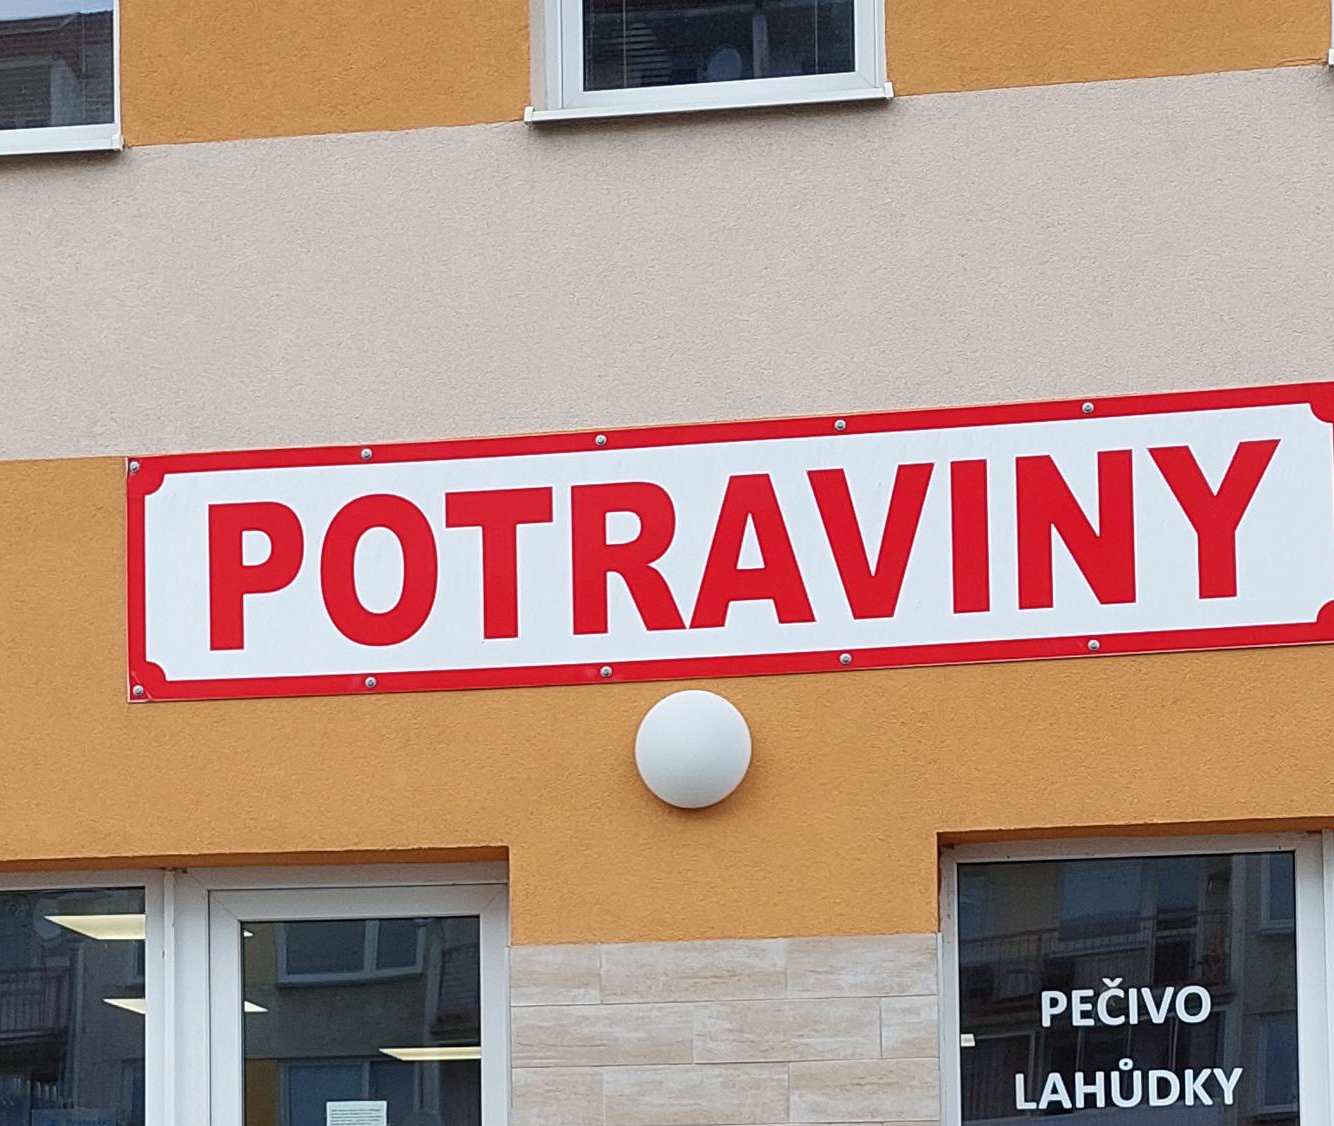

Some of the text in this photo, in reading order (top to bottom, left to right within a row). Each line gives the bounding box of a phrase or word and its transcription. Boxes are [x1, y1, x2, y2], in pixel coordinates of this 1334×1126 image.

[207, 438, 1282, 652] POTRAVINY
[1041, 977, 1212, 1028] PEČIVO
[1015, 1057, 1244, 1110] LAHŮDKY
